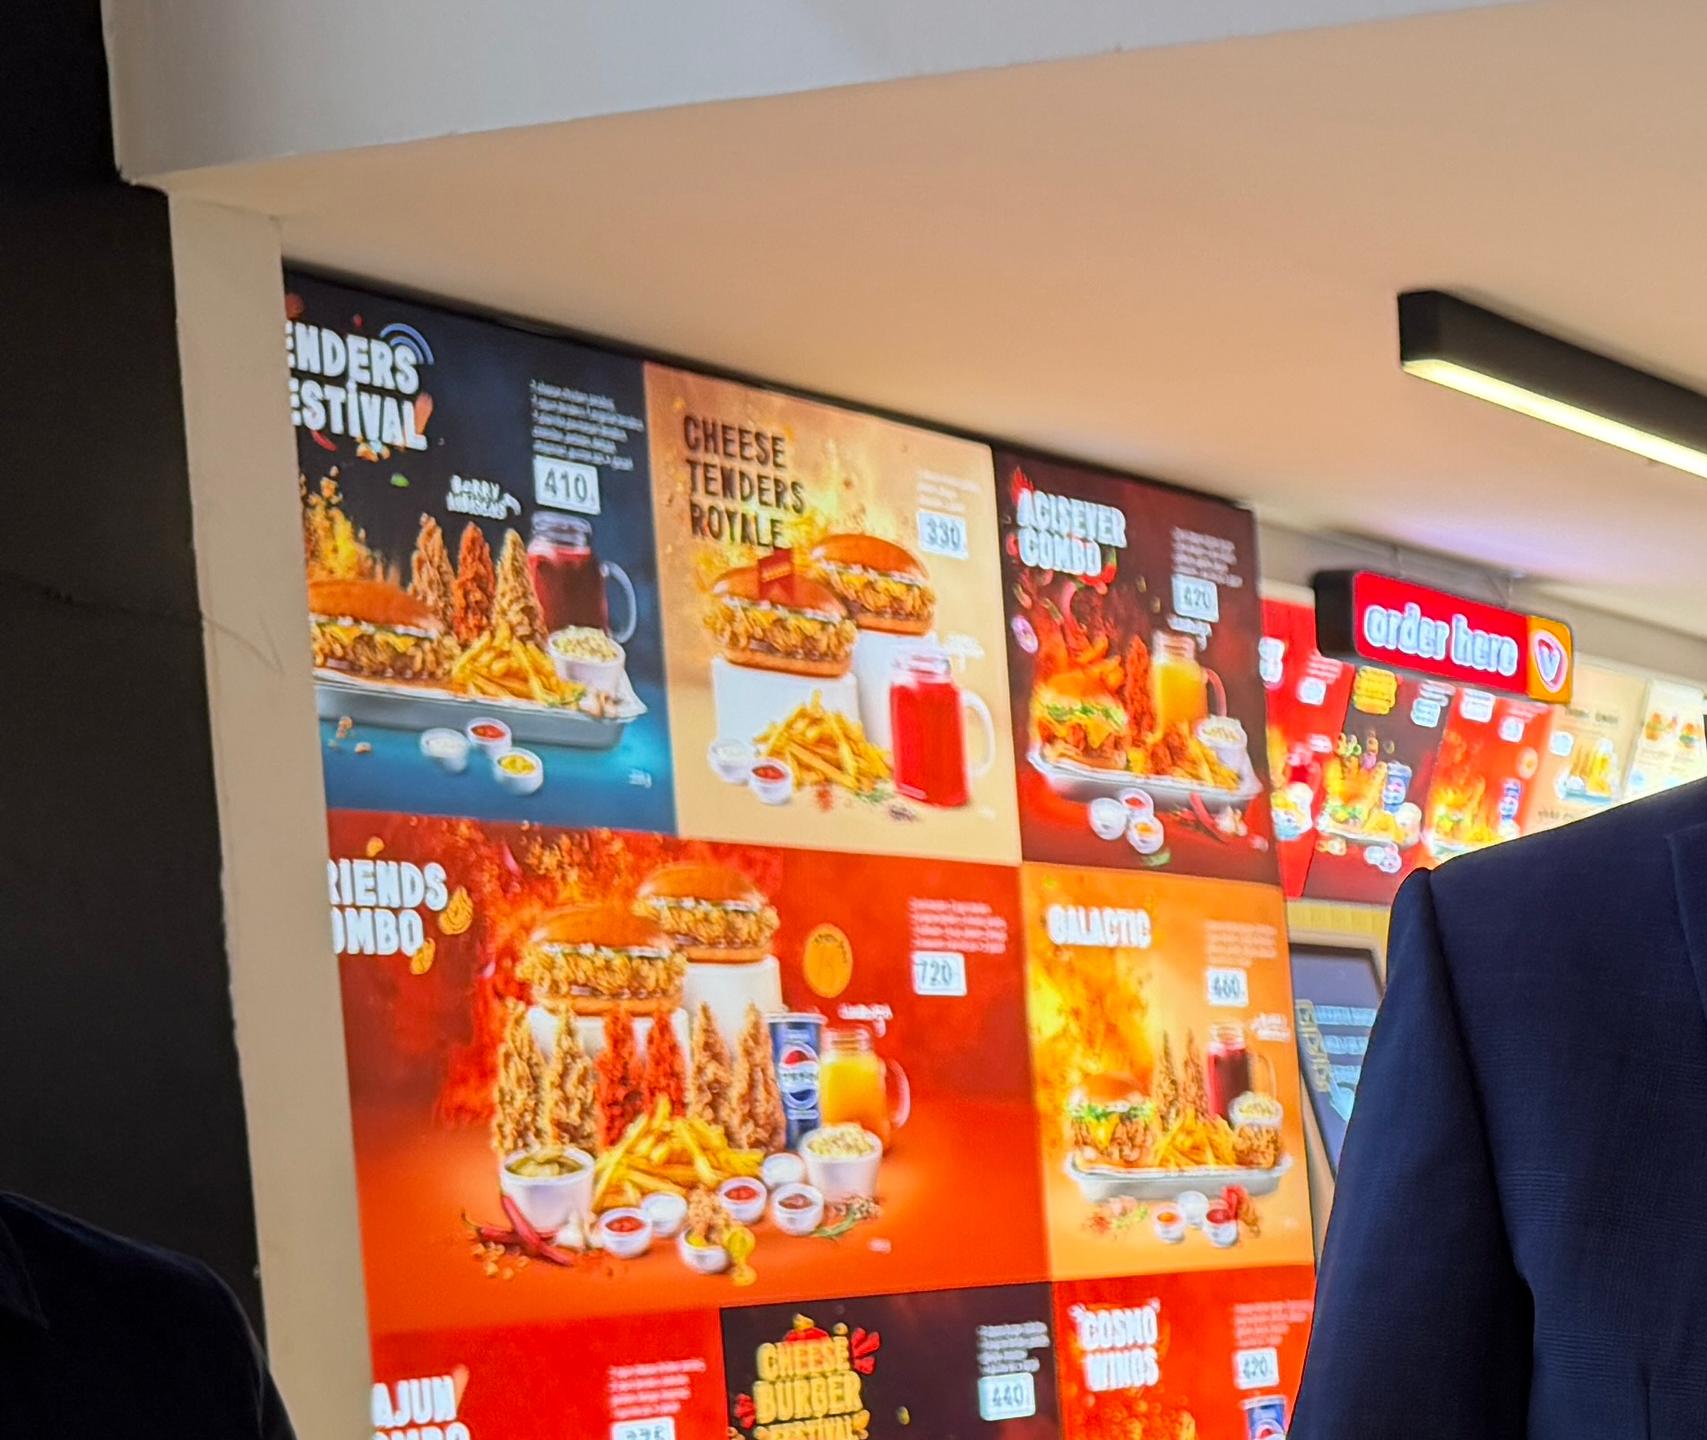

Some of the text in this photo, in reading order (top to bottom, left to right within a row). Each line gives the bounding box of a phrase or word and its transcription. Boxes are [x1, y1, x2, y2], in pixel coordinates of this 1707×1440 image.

[684, 415, 786, 468] CHEESE
[544, 470, 588, 502] 410
[685, 458, 806, 514] TENDERS
[690, 496, 791, 549] ROYALE
[927, 517, 961, 551] 330
[1018, 526, 1102, 577] COMBO
[1364, 601, 1450, 661] order
[1046, 903, 1152, 949] GALACTIC
[917, 959, 953, 985] 720
[1079, 1306, 1159, 1350] COSMO
[757, 1336, 850, 1381] CHEESE
[1086, 1347, 1160, 1392] WINGS
[754, 1371, 863, 1425] BURGER
[993, 1384, 1024, 1408] 440
